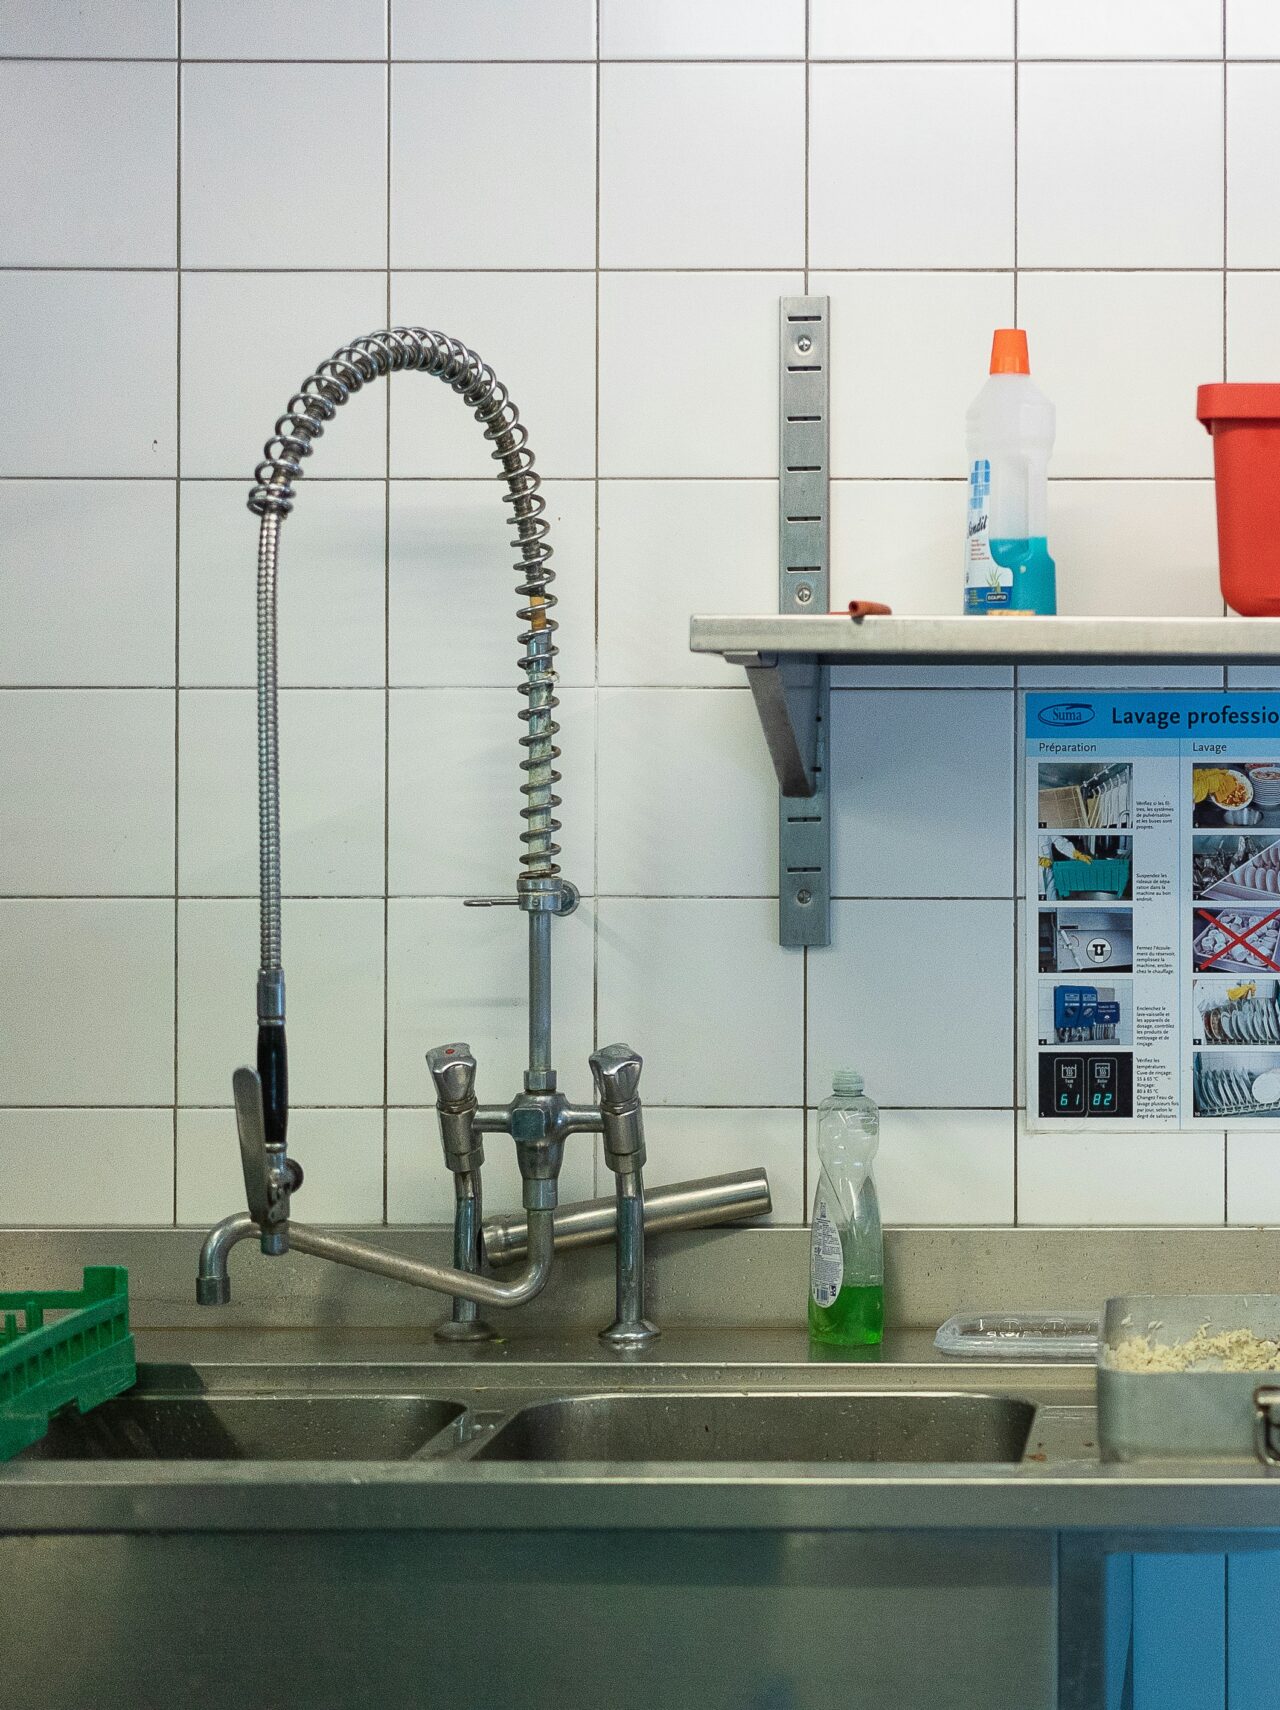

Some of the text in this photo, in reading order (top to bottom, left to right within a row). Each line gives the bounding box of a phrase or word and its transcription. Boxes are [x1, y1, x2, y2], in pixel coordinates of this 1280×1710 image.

[1052, 707, 1082, 721] Suma
[1112, 706, 1181, 729] Lavage
[1039, 742, 1097, 754] Préparation
[1192, 742, 1227, 754] Lavage
